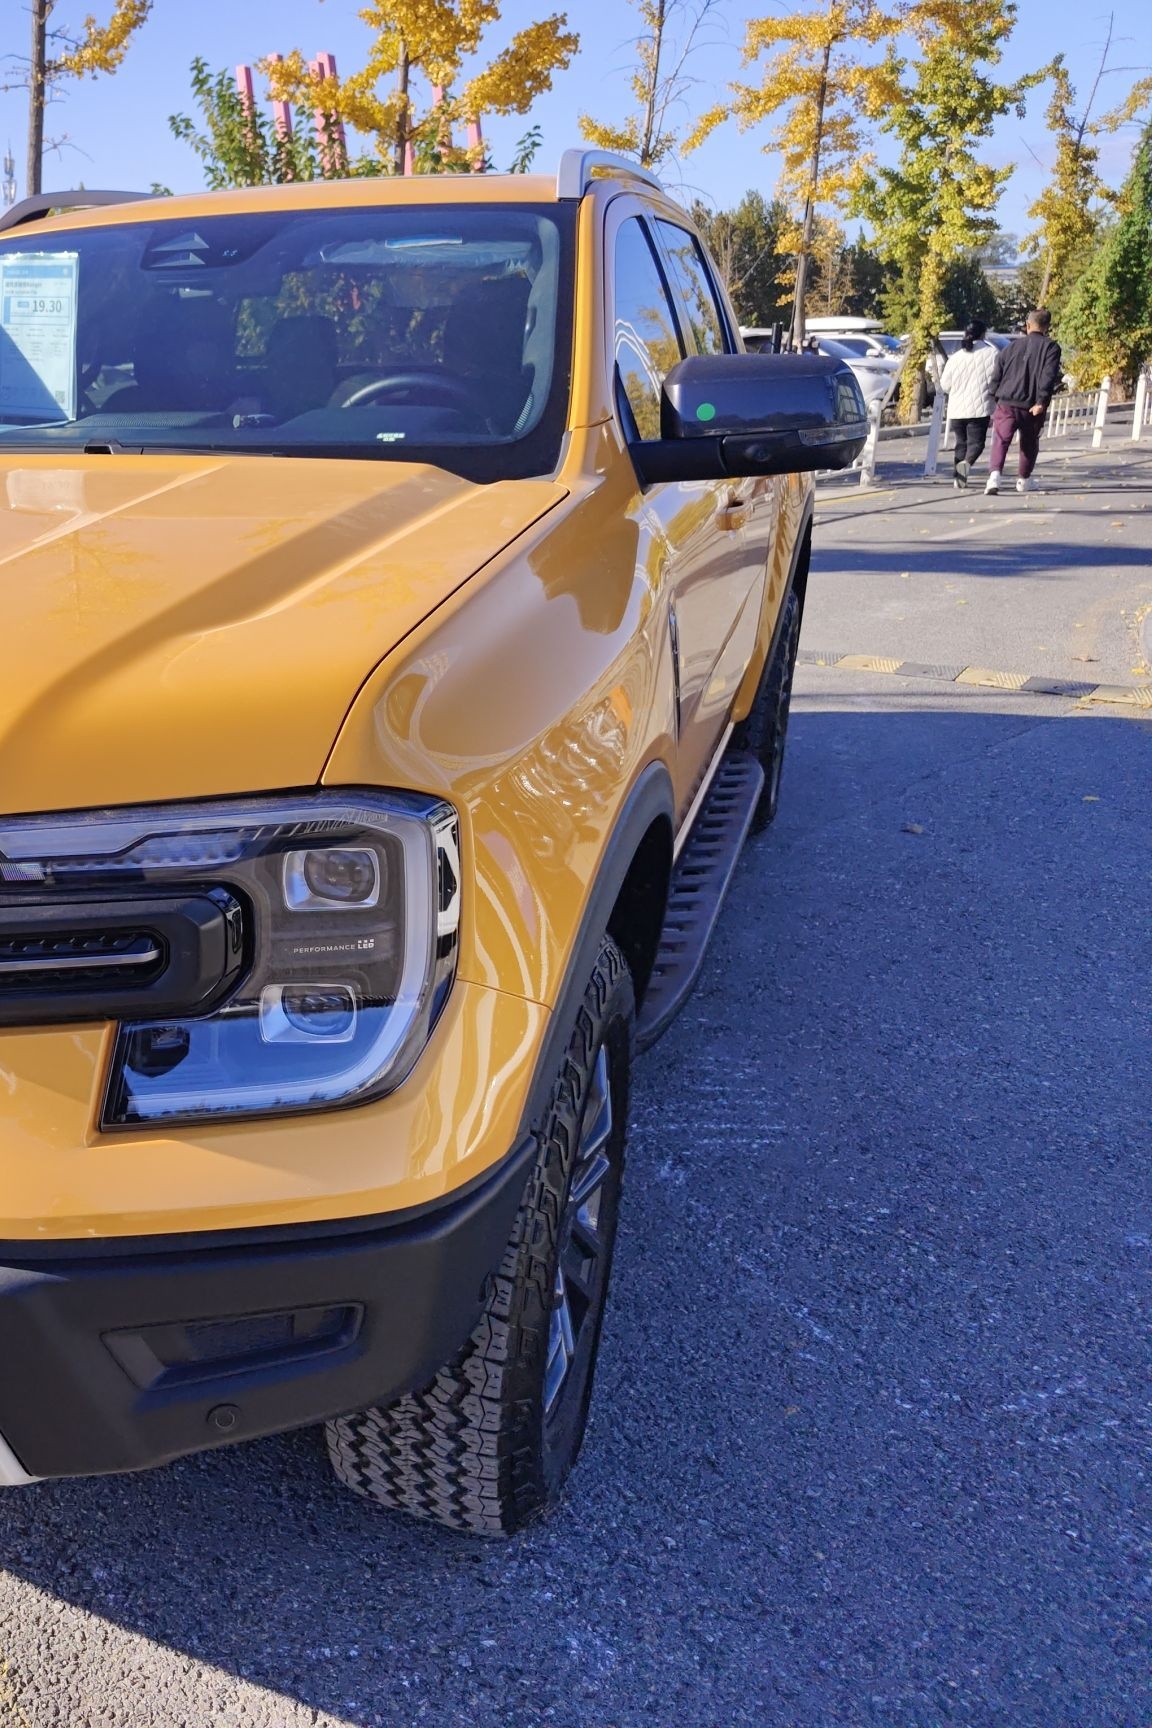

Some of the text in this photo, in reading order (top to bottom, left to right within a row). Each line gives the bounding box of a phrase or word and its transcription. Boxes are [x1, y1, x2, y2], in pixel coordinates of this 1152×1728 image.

[32, 299, 62, 313] 19.30
[293, 940, 375, 953] PERFORMANCE LED
